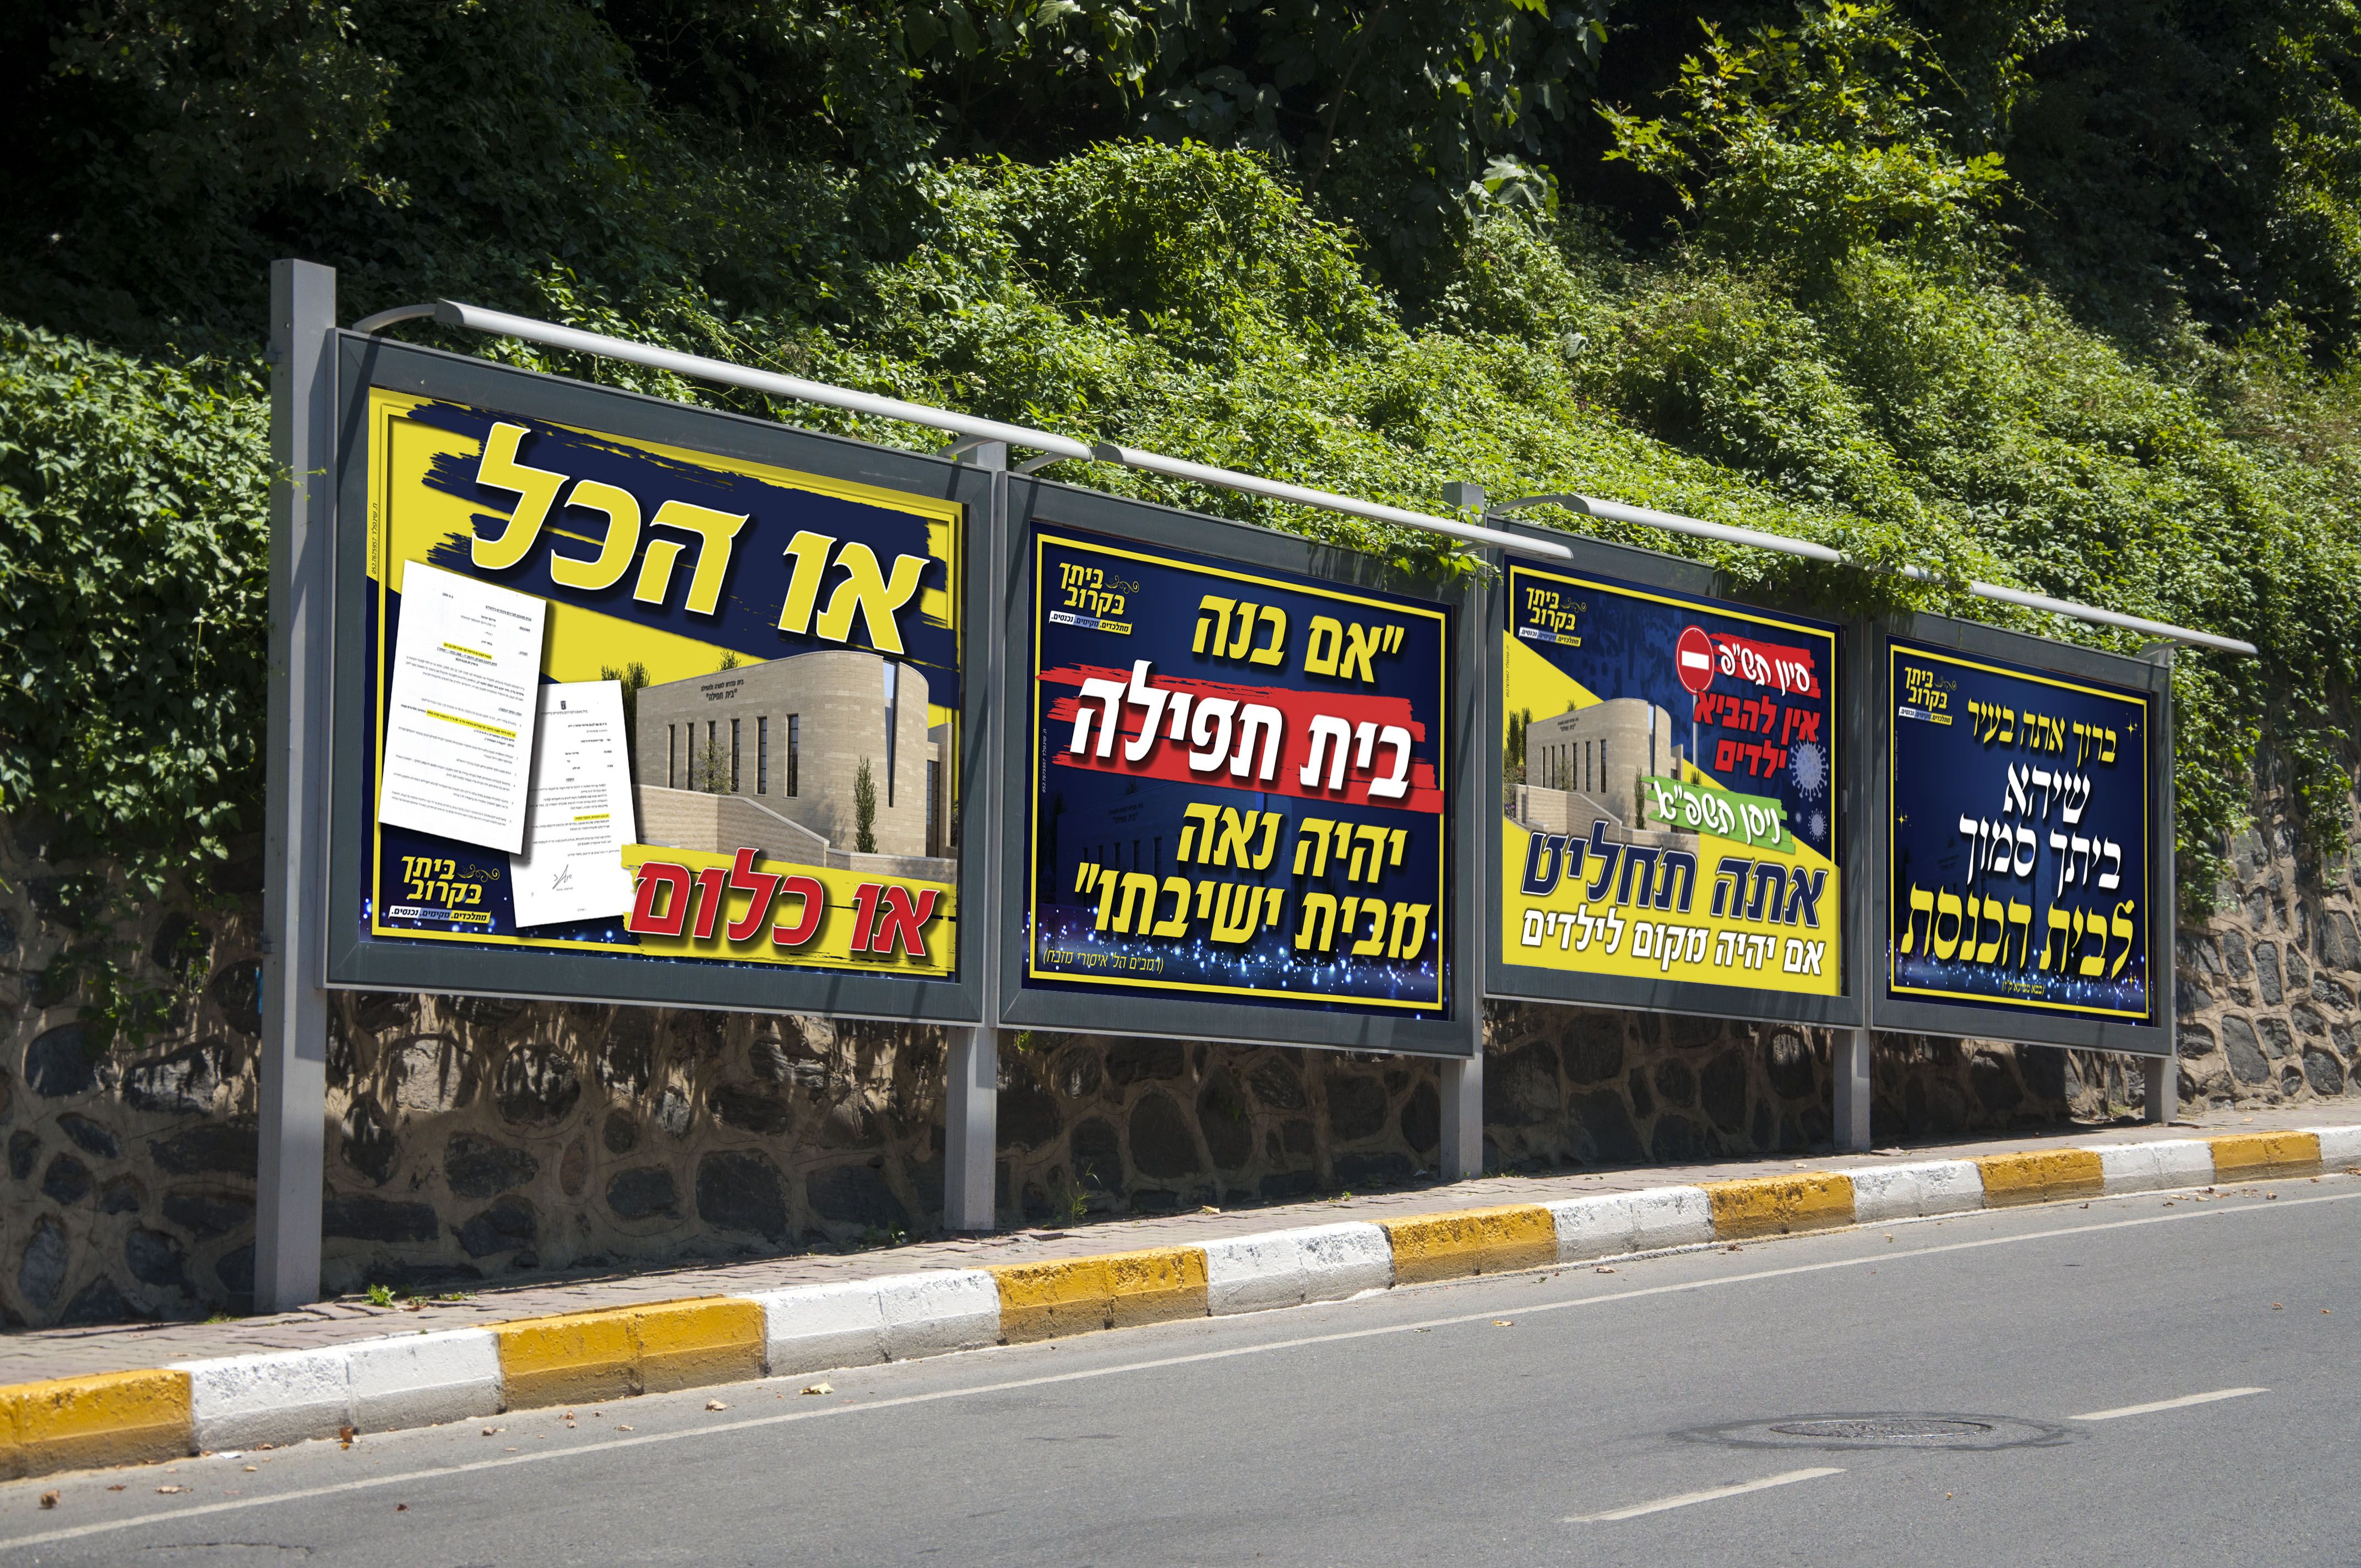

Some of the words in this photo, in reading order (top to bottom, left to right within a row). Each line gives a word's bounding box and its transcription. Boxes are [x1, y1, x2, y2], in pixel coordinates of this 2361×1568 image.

[471, 422, 750, 615] הכל
[778, 530, 930, 654] או
[1051, 613, 1074, 623] נכנסים.
[1074, 618, 1099, 628] מקימים.
[1100, 622, 1129, 633] מתלכדים.
[1192, 595, 1286, 666] בנה
[1304, 616, 1405, 683] "אם
[1719, 643, 1771, 685] תש"פ
[725, 688, 738, 699] "בית
[1775, 659, 1810, 696] סיון
[1070, 660, 1282, 780] תפילה
[1694, 691, 1777, 733] להביא
[1781, 707, 1820, 745] אין
[1968, 699, 2015, 743] בעיר
[2020, 710, 2065, 753] אתה
[1300, 714, 1411, 798] בית
[1715, 739, 1787, 778] ילדים
[2073, 721, 2117, 767] ברוך
[1654, 780, 1736, 837] תשפ"א
[2003, 762, 2090, 824] שיהא
[1176, 803, 1282, 870] נאה
[1739, 803, 1780, 844] ניסן
[1292, 818, 1408, 883] יהיה
[1521, 820, 1698, 911] תחליט
[1959, 813, 2036, 885] סמוך
[2049, 828, 2121, 898] ביתך
[391, 908, 418, 916] נכנסים.
[420, 910, 450, 919] מקימים.
[451, 912, 487, 922] מתלכדים.
[629, 848, 824, 948] כלום
[1074, 862, 1285, 944] ישיבתו"
[1710, 859, 1828, 927] אתה
[850, 883, 939, 955] או
[1295, 892, 1432, 960] מבית
[1521, 905, 1625, 953] לילדים
[1900, 882, 2032, 968] הכנסת
[2039, 900, 2135, 978] לבית
[1043, 948, 1074, 965] מזבח)
[1077, 952, 1108, 967] איסורי
[1129, 957, 1163, 974] (רמב"ם
[1632, 922, 1709, 971] מקום
[1715, 932, 1776, 968] יהיה
[1783, 939, 1825, 974] אם
